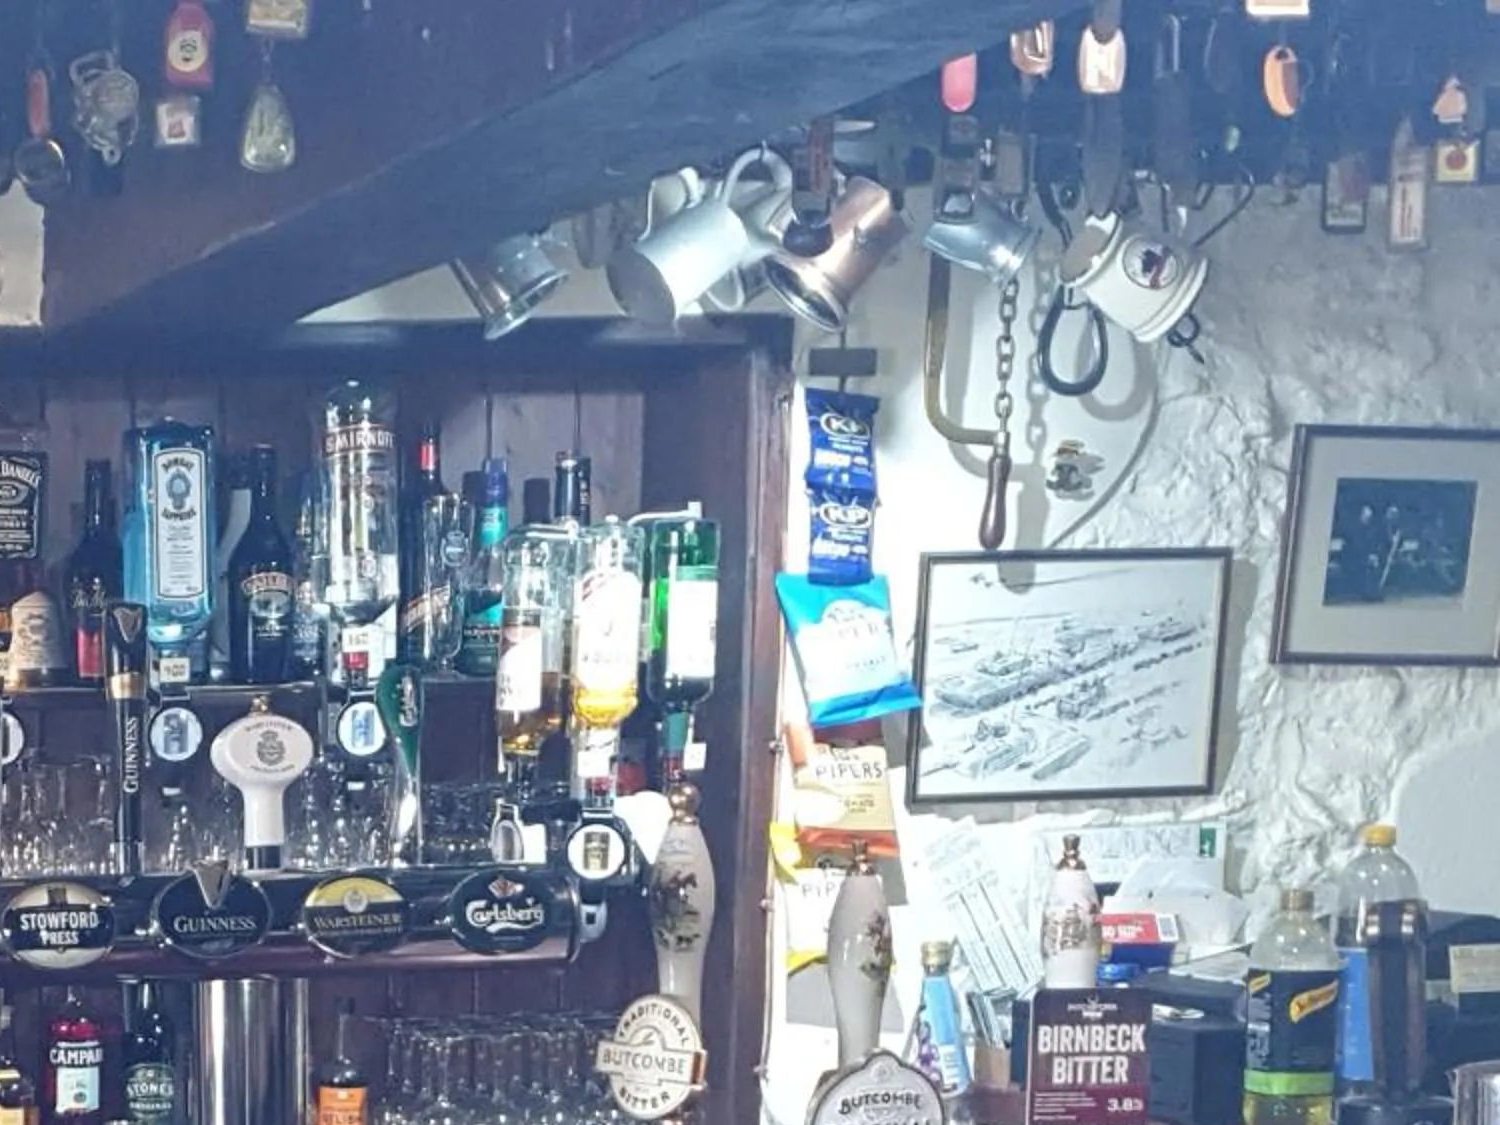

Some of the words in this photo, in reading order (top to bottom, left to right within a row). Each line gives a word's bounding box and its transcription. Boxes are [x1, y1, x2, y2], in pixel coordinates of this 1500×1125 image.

[123, 715, 140, 794] GUINNESS
[19, 911, 100, 931] STOWFORD
[173, 915, 258, 933] GUINNESS
[465, 898, 545, 932] Carlsberg
[39, 930, 80, 946] PRESS
[619, 1003, 690, 1048] TRADITIONAL
[1037, 1023, 1146, 1054] BIRNBECK
[602, 1047, 688, 1075] BUTCOMBE
[1052, 1055, 1130, 1085] BITTER
[619, 1086, 671, 1111] BITTER
[838, 1091, 923, 1116] BUTCOMBE
